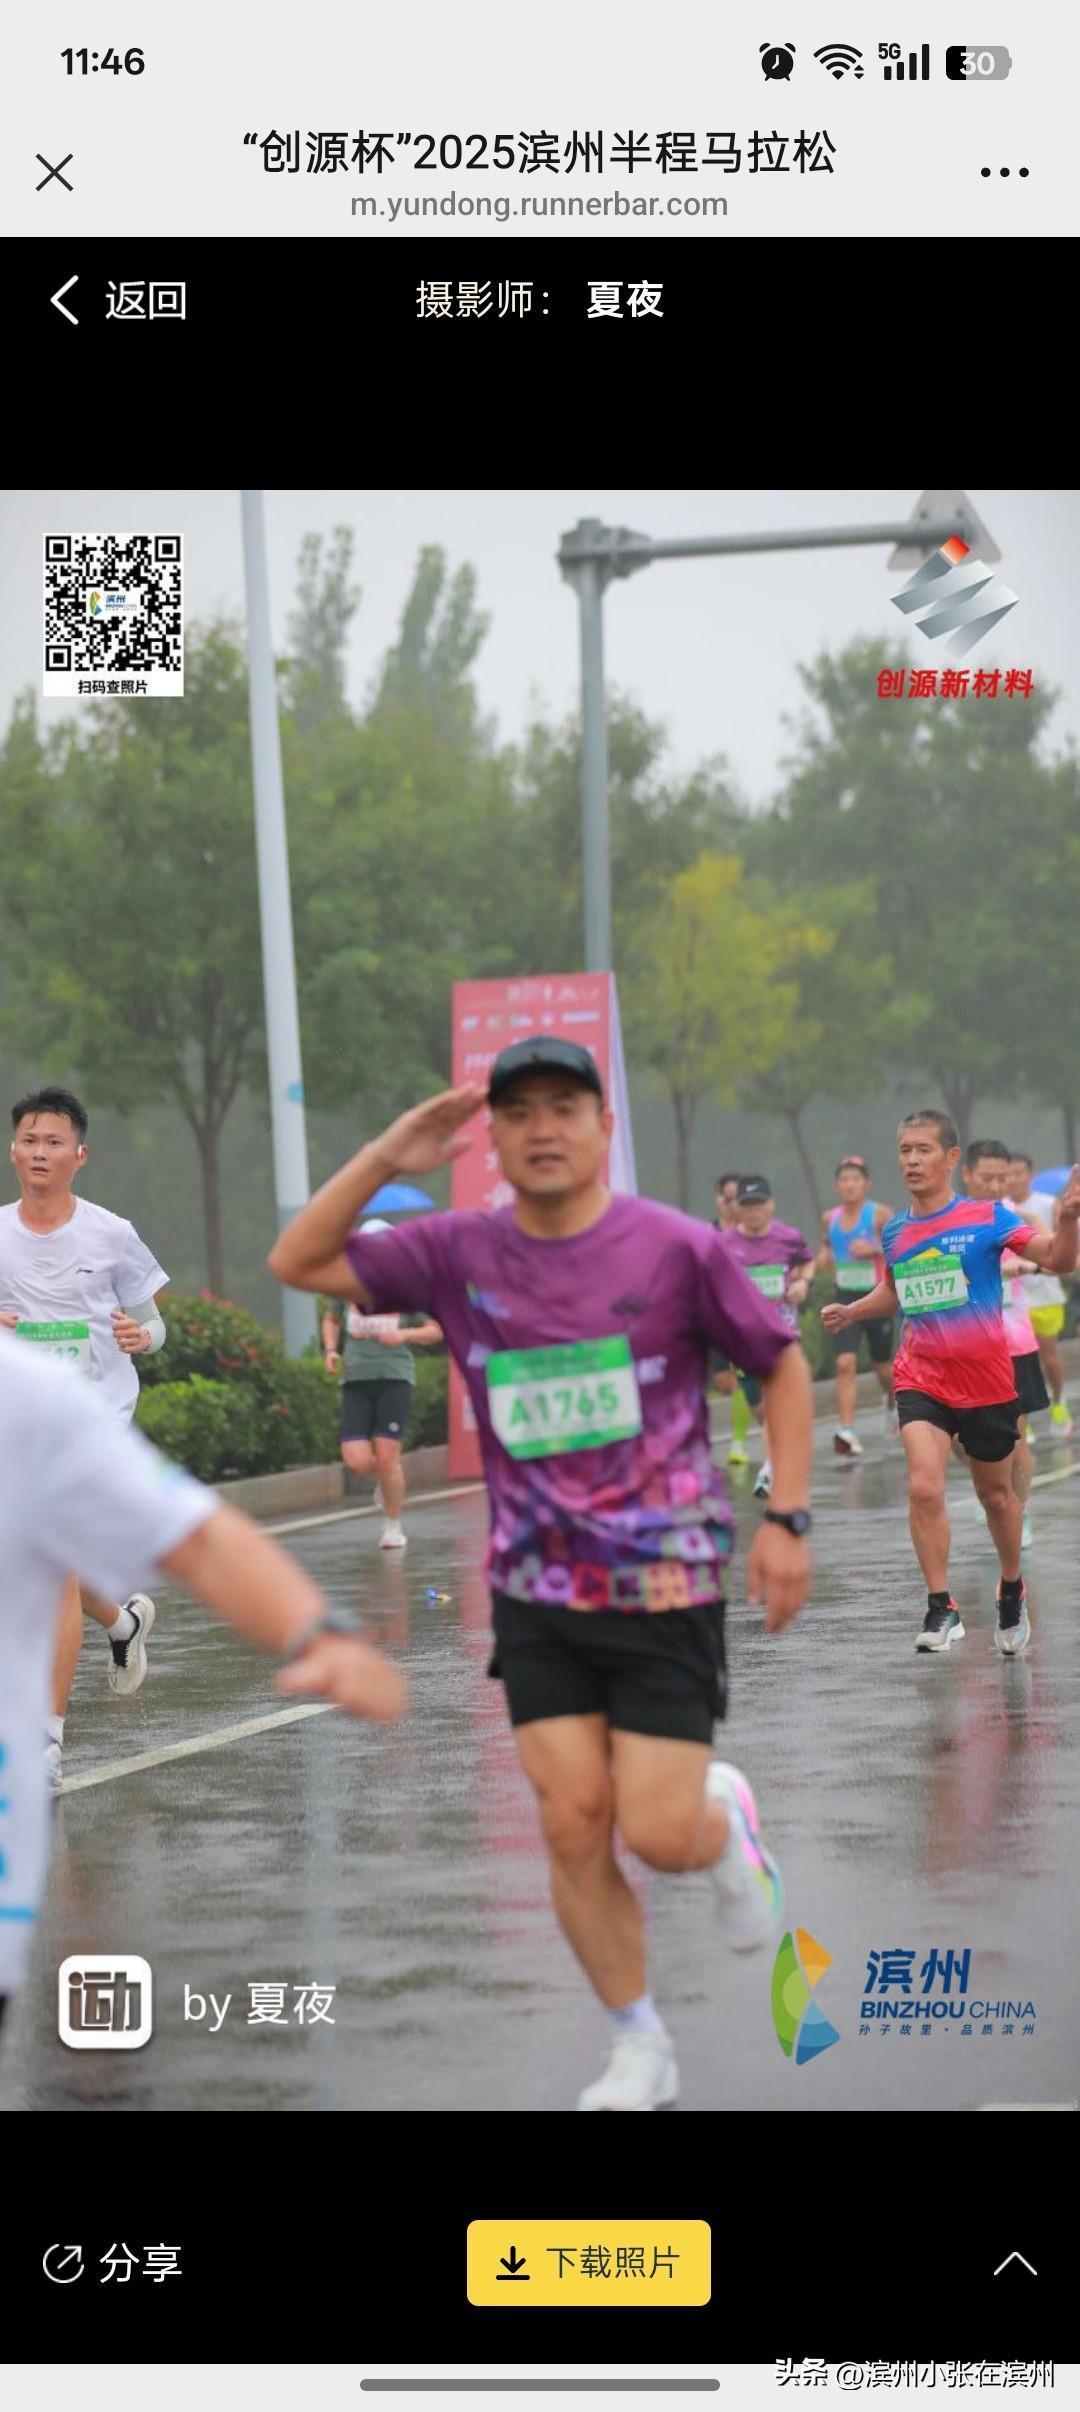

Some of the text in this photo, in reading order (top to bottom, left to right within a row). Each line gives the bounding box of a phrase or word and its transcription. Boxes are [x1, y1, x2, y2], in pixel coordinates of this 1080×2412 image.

[61, 48, 145, 76] 11:46
[878, 43, 901, 60] 5G
[960, 51, 995, 75] 30
[244, 130, 837, 175] “创源杯”2025滨州半程马拉松
[352, 191, 728, 223] m.yundong.runnerbar.com
[105, 280, 186, 321] 返回
[586, 280, 664, 319] 夏夜
[904, 1277, 956, 1300] A1577
[509, 1384, 620, 1426] A1765
[99, 2242, 183, 2284] 分享
[545, 2244, 681, 2280] 下载照片
